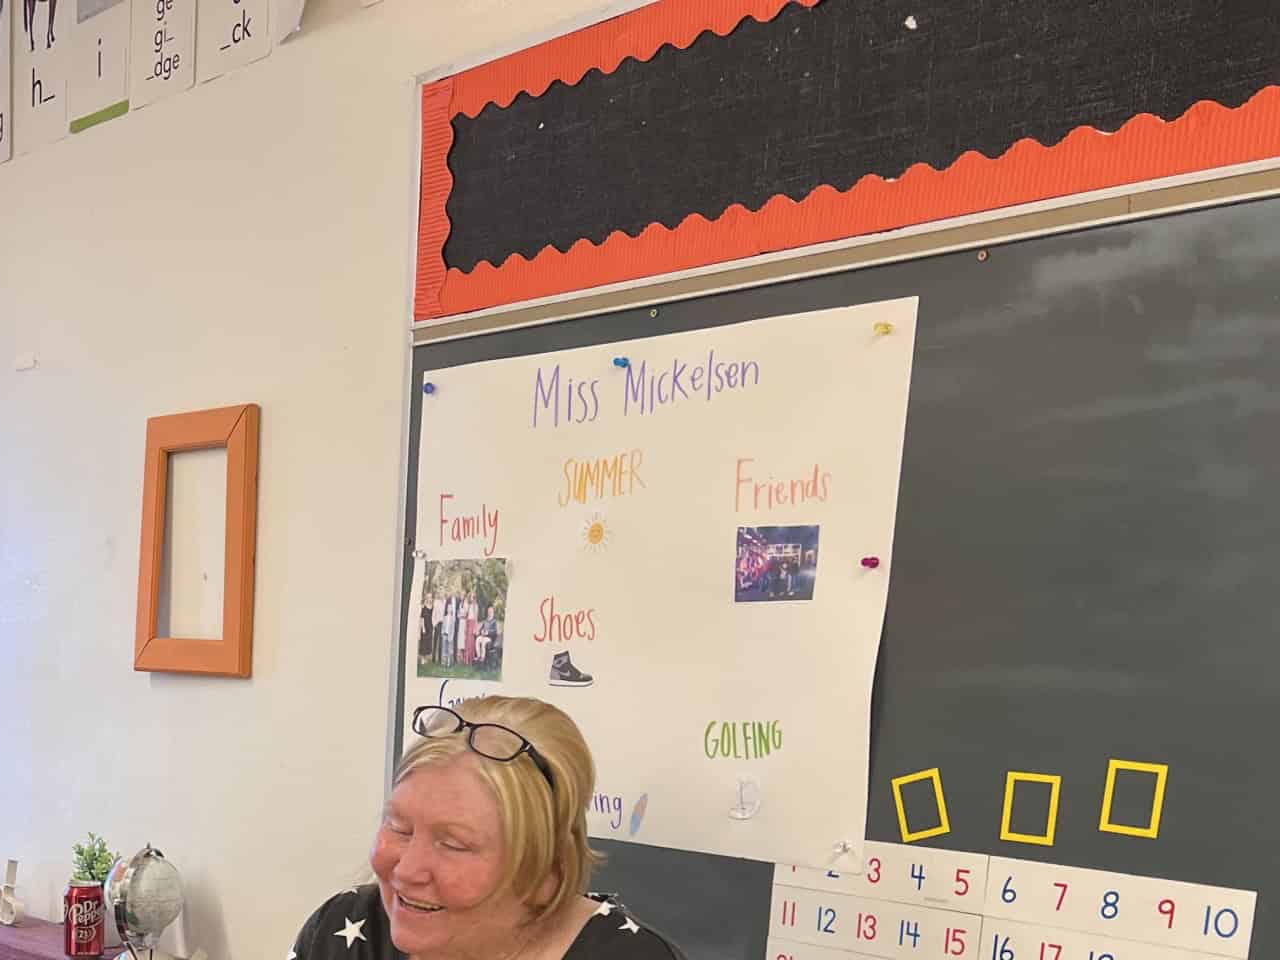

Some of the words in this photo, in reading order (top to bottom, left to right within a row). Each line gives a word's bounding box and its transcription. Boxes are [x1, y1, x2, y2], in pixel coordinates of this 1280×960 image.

[98, 38, 103, 79] i
[533, 364, 599, 428] Miss
[623, 349, 760, 417] Mickelsen
[558, 448, 647, 508] SUMMER
[735, 458, 832, 513] Friends
[439, 493, 499, 557] Family
[533, 596, 597, 643] Shoes
[704, 719, 782, 760] GOLFING
[867, 858, 881, 884] 3
[911, 863, 926, 891] 4
[954, 868, 971, 896] 5
[1001, 878, 1017, 904] 6
[1053, 882, 1068, 911] 7
[1100, 891, 1120, 919] 8
[1158, 899, 1175, 929] 9
[1203, 905, 1239, 938] 10
[782, 900, 796, 927] 11
[817, 906, 836, 934] 12
[857, 913, 877, 940] 13
[899, 920, 920, 948] 14
[944, 927, 967, 956] 15
